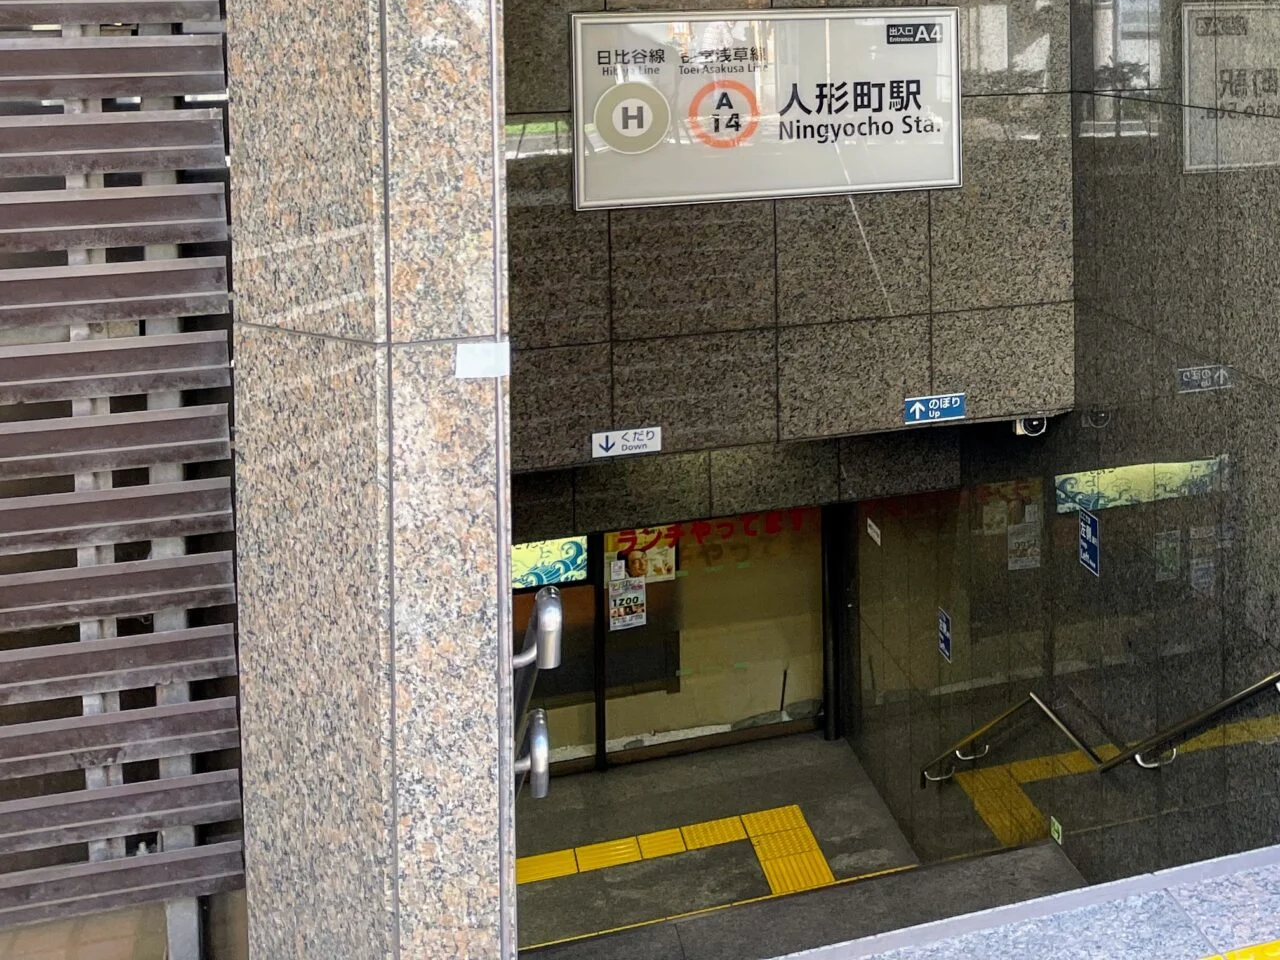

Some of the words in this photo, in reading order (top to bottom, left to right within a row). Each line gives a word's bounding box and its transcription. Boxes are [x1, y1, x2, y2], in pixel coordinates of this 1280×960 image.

[889, 26, 914, 36] 出入口
[914, 24, 942, 42] A4
[597, 48, 666, 66] 日比谷線
[679, 65, 700, 75] Toei
[703, 63, 744, 74] Asakusa
[715, 91, 734, 110] A
[778, 79, 922, 116] 人形町駅
[621, 106, 645, 130] H
[712, 112, 742, 133] 14
[778, 117, 894, 144] Ningyocho
[902, 115, 941, 134] Sta.
[928, 396, 961, 410] のぼり
[928, 409, 940, 419] Up
[620, 428, 656, 442] くだり
[621, 442, 648, 452] Down
